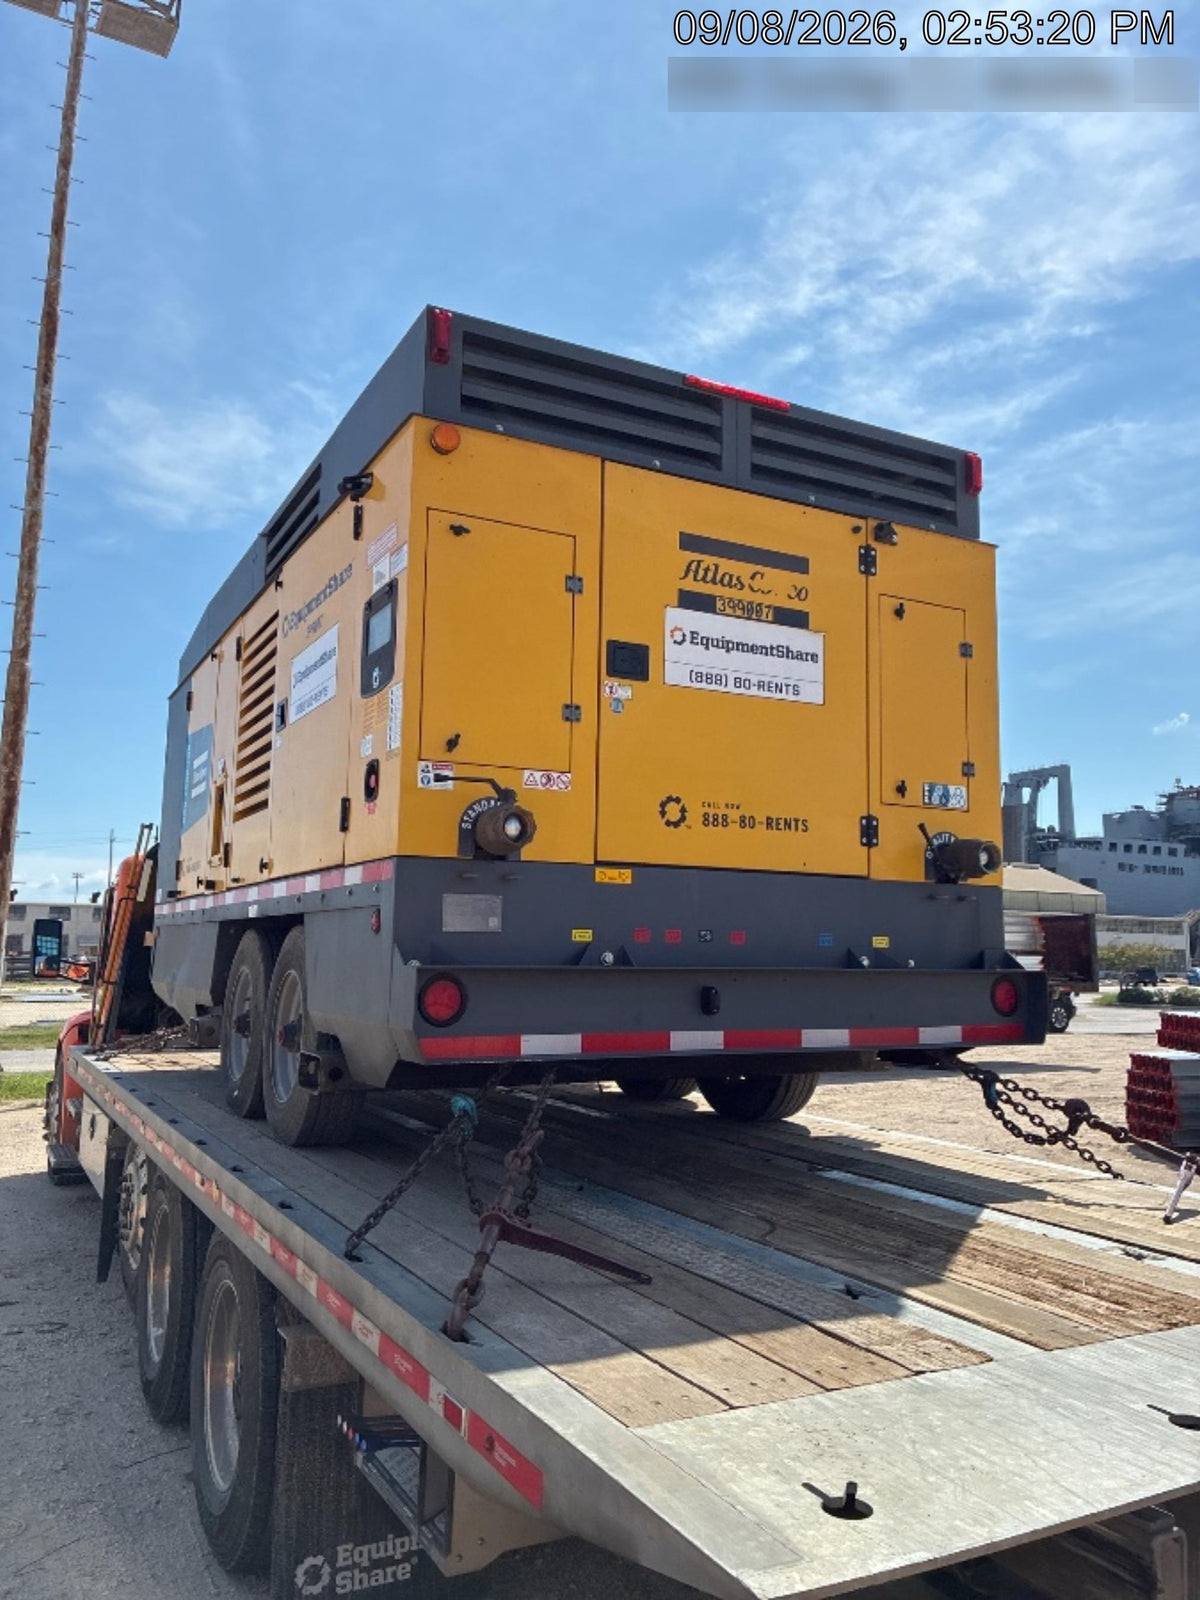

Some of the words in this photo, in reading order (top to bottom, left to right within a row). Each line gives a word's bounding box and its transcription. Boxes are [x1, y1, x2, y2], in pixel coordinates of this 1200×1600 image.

[679, 559, 746, 591] Atlas
[689, 630, 819, 664] EquipmentShare
[689, 669, 728, 688] (888)
[733, 676, 801, 697] 80-RENTS
[701, 811, 809, 833] 888-80-RENTS
[335, 1561, 412, 1595] Share
